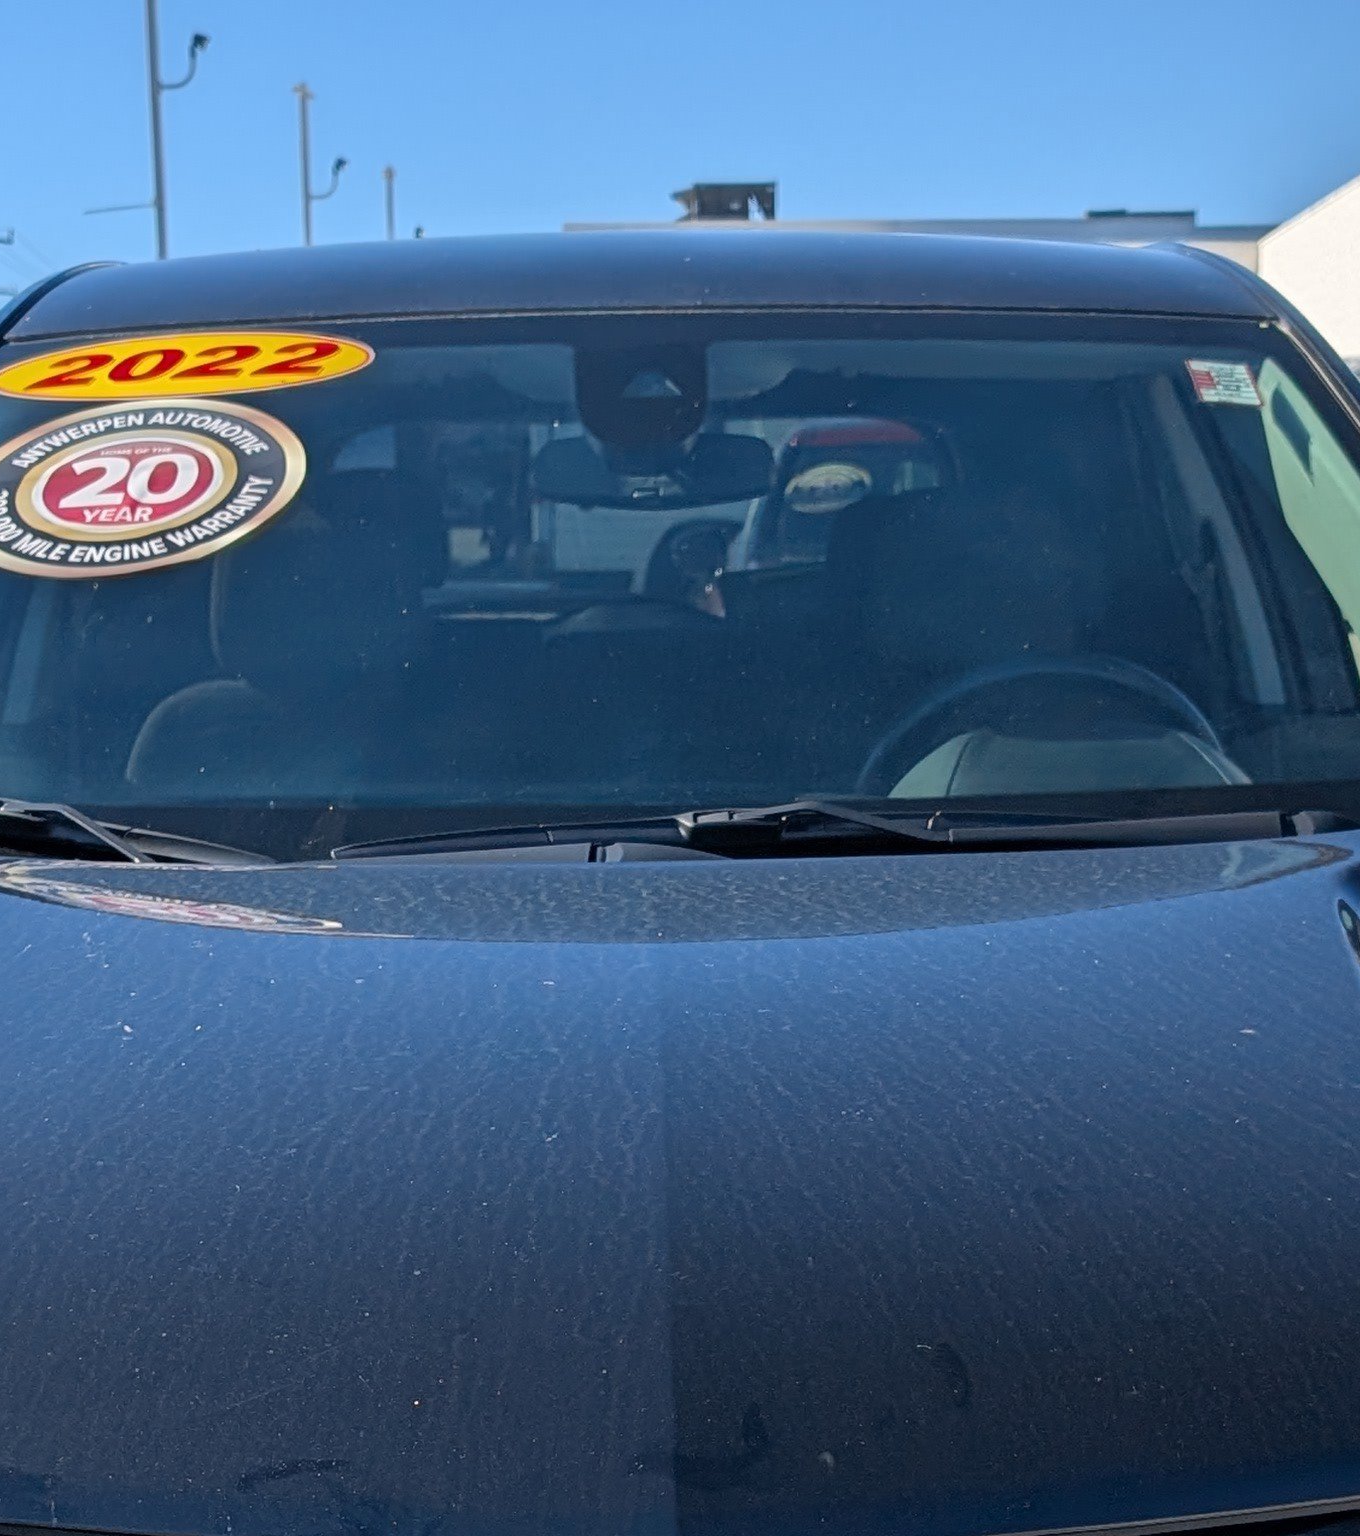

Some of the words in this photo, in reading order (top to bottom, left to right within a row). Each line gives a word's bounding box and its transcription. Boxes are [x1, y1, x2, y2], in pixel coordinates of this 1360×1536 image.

[25, 341, 342, 390] 2022
[11, 412, 145, 470] ANTWERPEN
[147, 410, 271, 456] AUTOMOTIVE
[58, 453, 201, 510] 20
[12, 532, 71, 563] MILE
[67, 536, 170, 563] ENGINE
[164, 474, 275, 548] WARRANTY
[81, 506, 154, 523] YEAR
